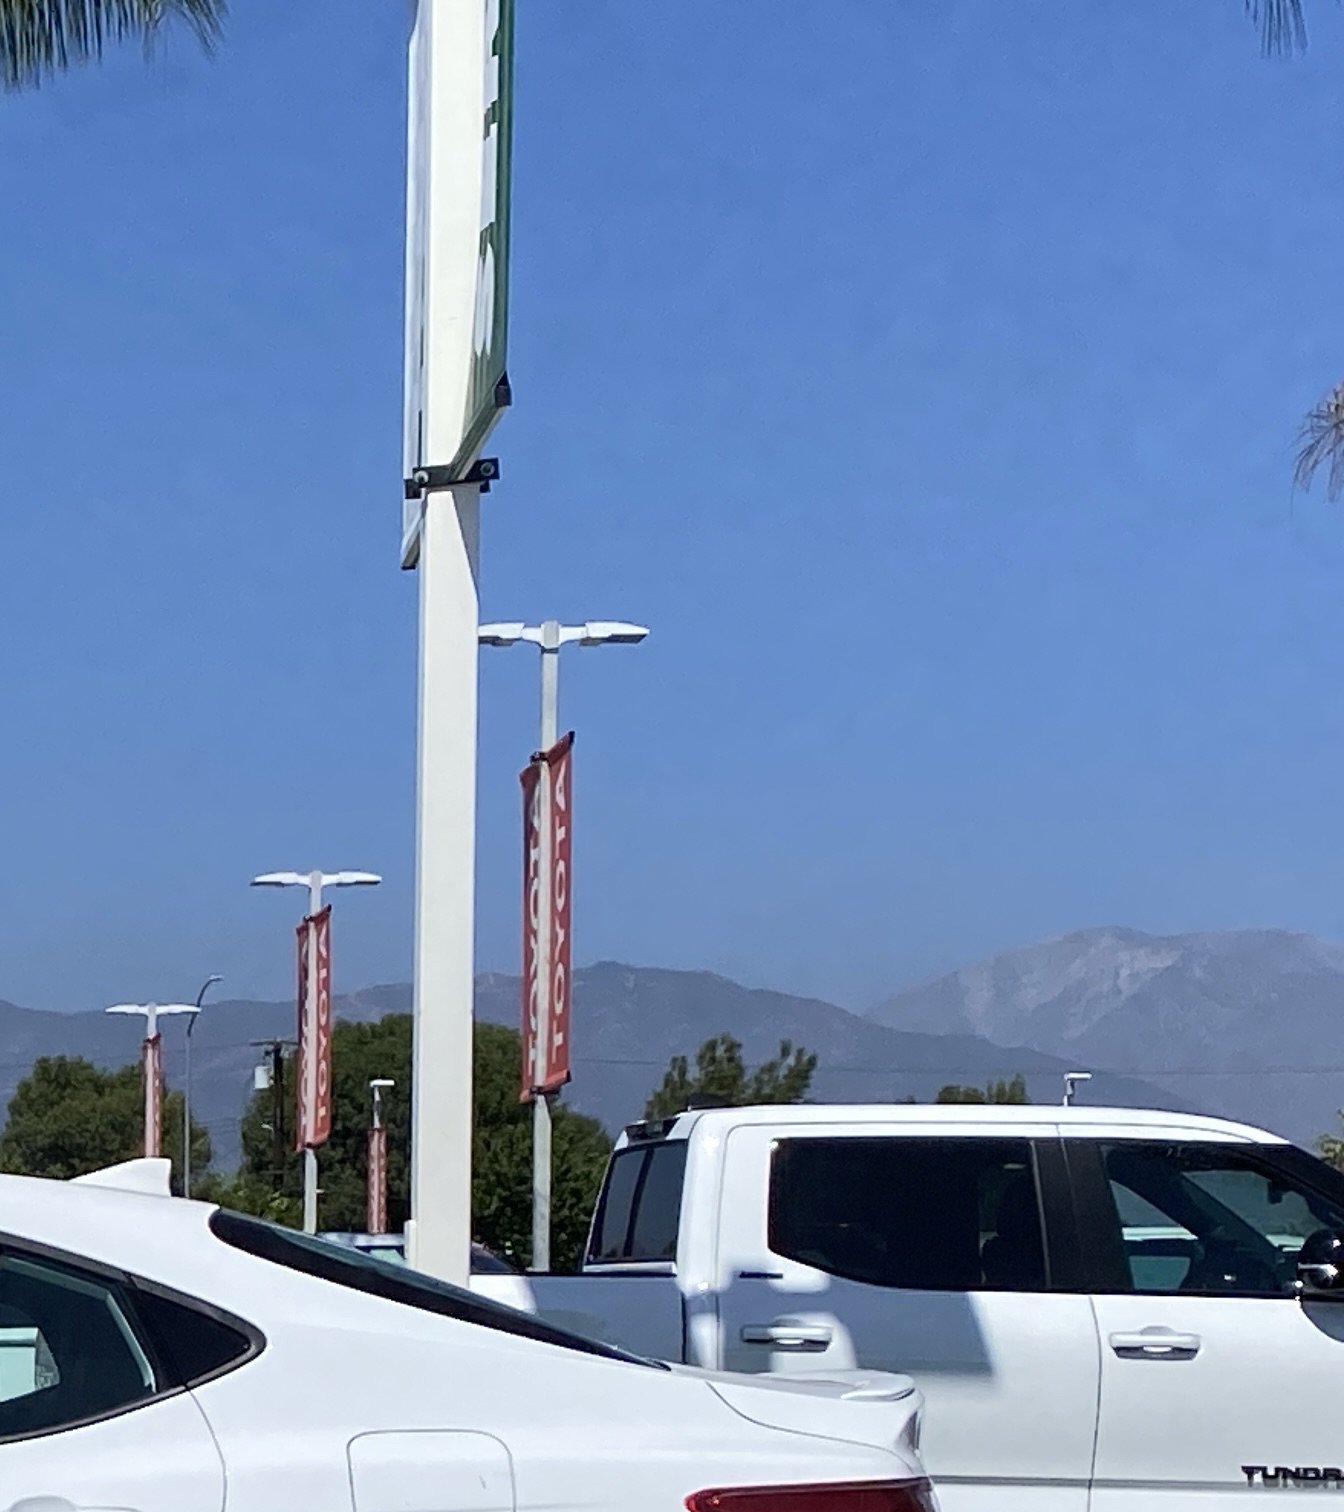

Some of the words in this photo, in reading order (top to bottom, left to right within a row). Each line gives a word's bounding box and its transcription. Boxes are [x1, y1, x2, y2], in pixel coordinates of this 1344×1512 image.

[552, 760, 567, 1064] TOYOTA
[317, 923, 328, 1128] TOYOTA
[1240, 1466, 1344, 1489] TUNDR
